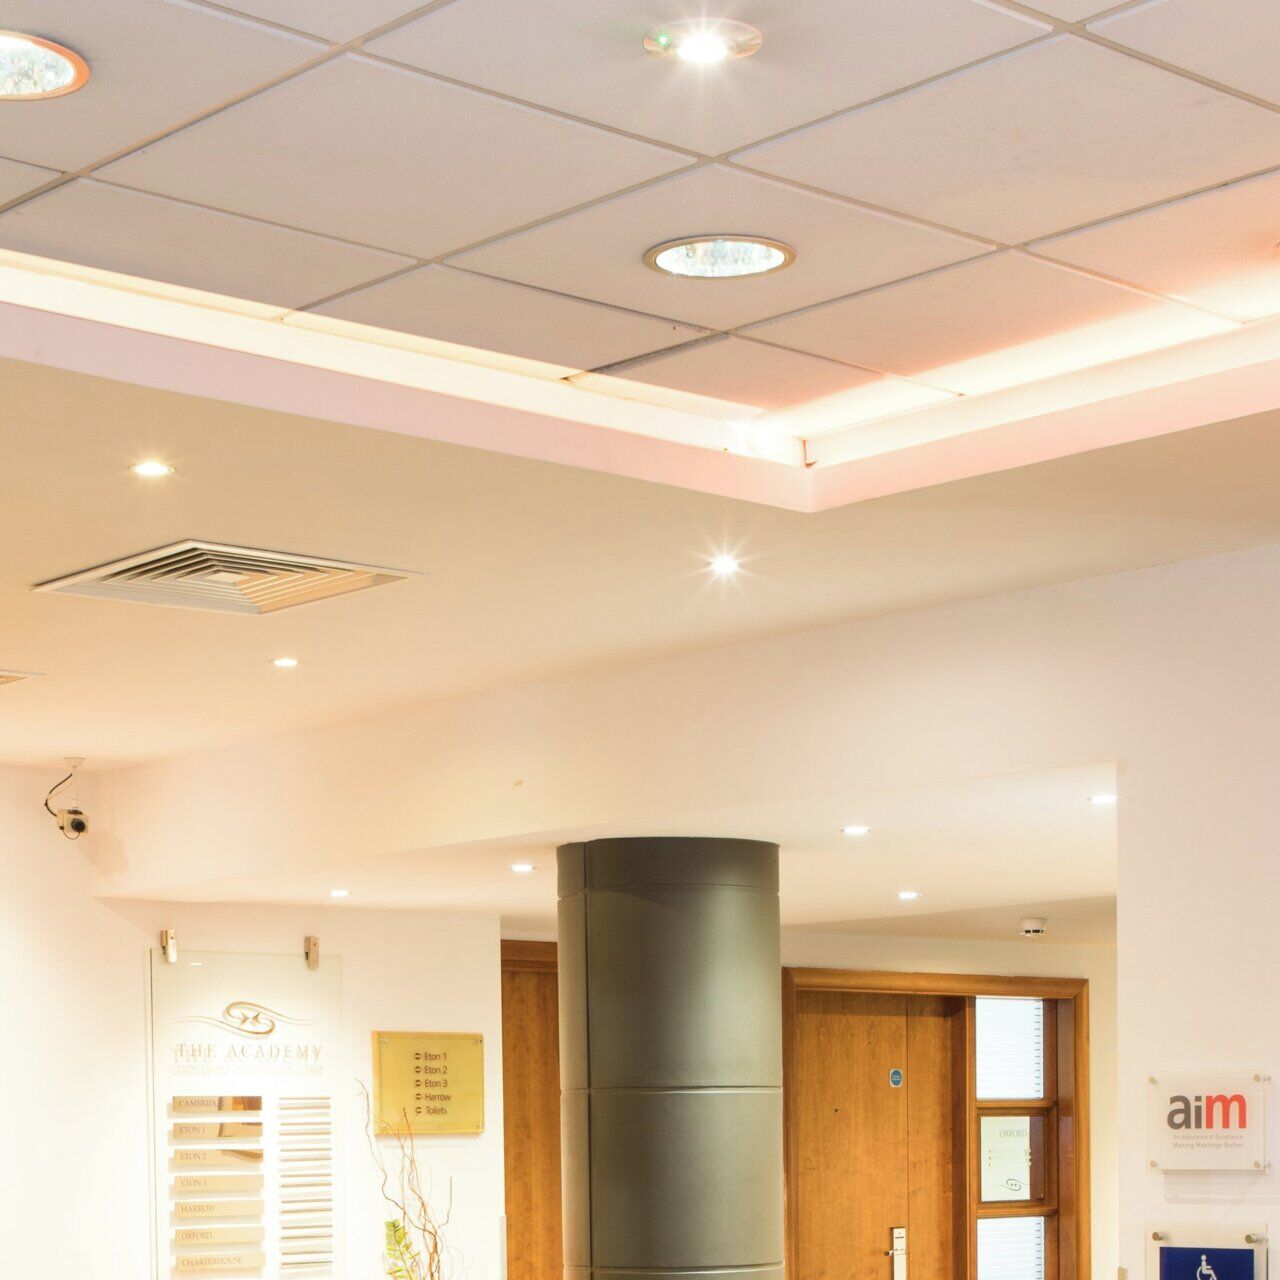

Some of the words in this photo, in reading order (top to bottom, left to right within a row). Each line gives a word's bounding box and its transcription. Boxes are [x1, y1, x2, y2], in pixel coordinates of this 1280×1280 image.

[176, 1043, 216, 1058] THE
[227, 1043, 322, 1059] ACADEMY
[424, 1052, 440, 1061] Eton
[443, 1052, 447, 1061] 1
[424, 1065, 441, 1074] Eton
[442, 1065, 448, 1074] 2
[424, 1079, 441, 1088] Eton
[442, 1079, 448, 1088] 3
[425, 1093, 451, 1101] Harrow
[425, 1106, 447, 1115] Toilets
[1166, 1094, 1247, 1130] aim
[179, 1126, 200, 1134] ETON
[999, 1129, 1027, 1138] OXFORD
[180, 1152, 201, 1160] ETON
[180, 1179, 201, 1187] ETON
[181, 1204, 216, 1213] HARROW
[181, 1231, 213, 1240] OXFORD
[181, 1256, 242, 1267] CHARTERHOUSE
